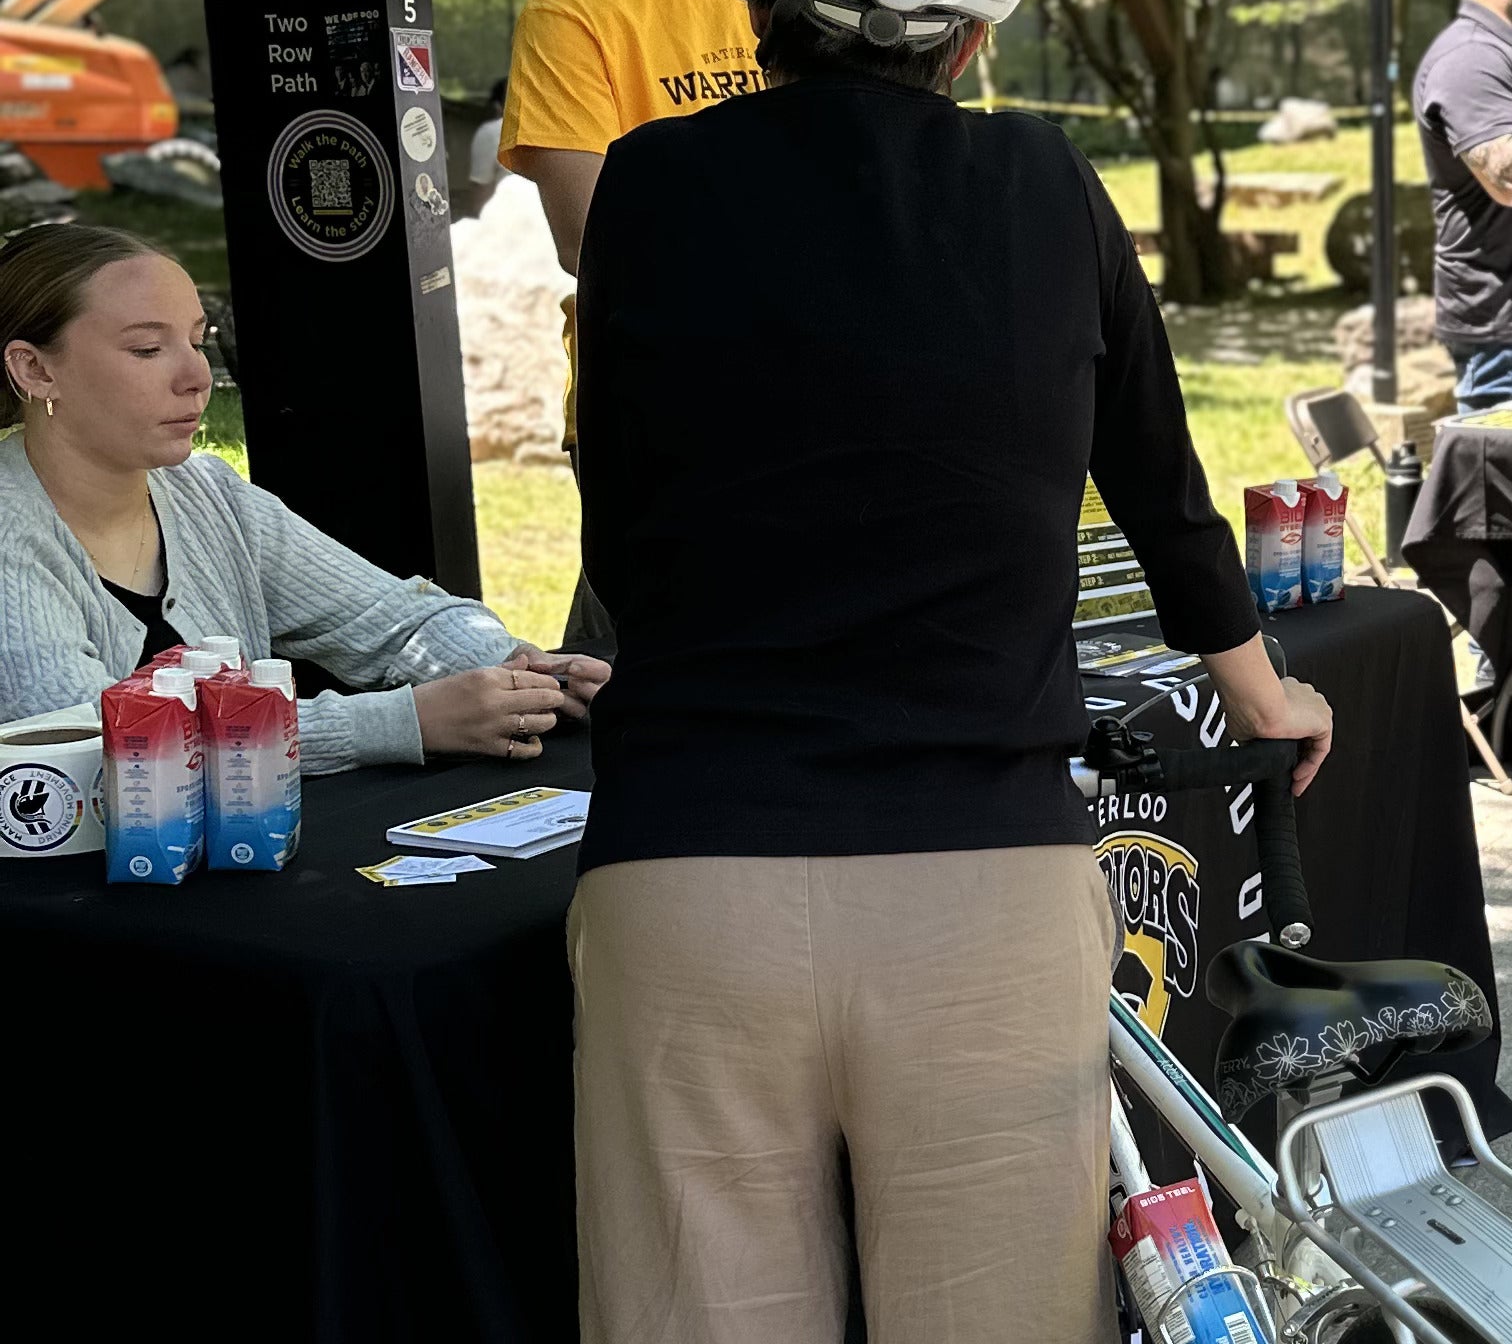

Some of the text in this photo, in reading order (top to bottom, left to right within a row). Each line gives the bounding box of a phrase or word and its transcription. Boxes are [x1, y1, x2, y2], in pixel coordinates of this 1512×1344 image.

[264, 14, 308, 33] Two
[268, 44, 312, 63] Row
[271, 72, 318, 93] Path
[288, 133, 368, 170] Walk the path
[291, 196, 374, 237] Learn the story
[1087, 792, 1168, 828] ERLOO
